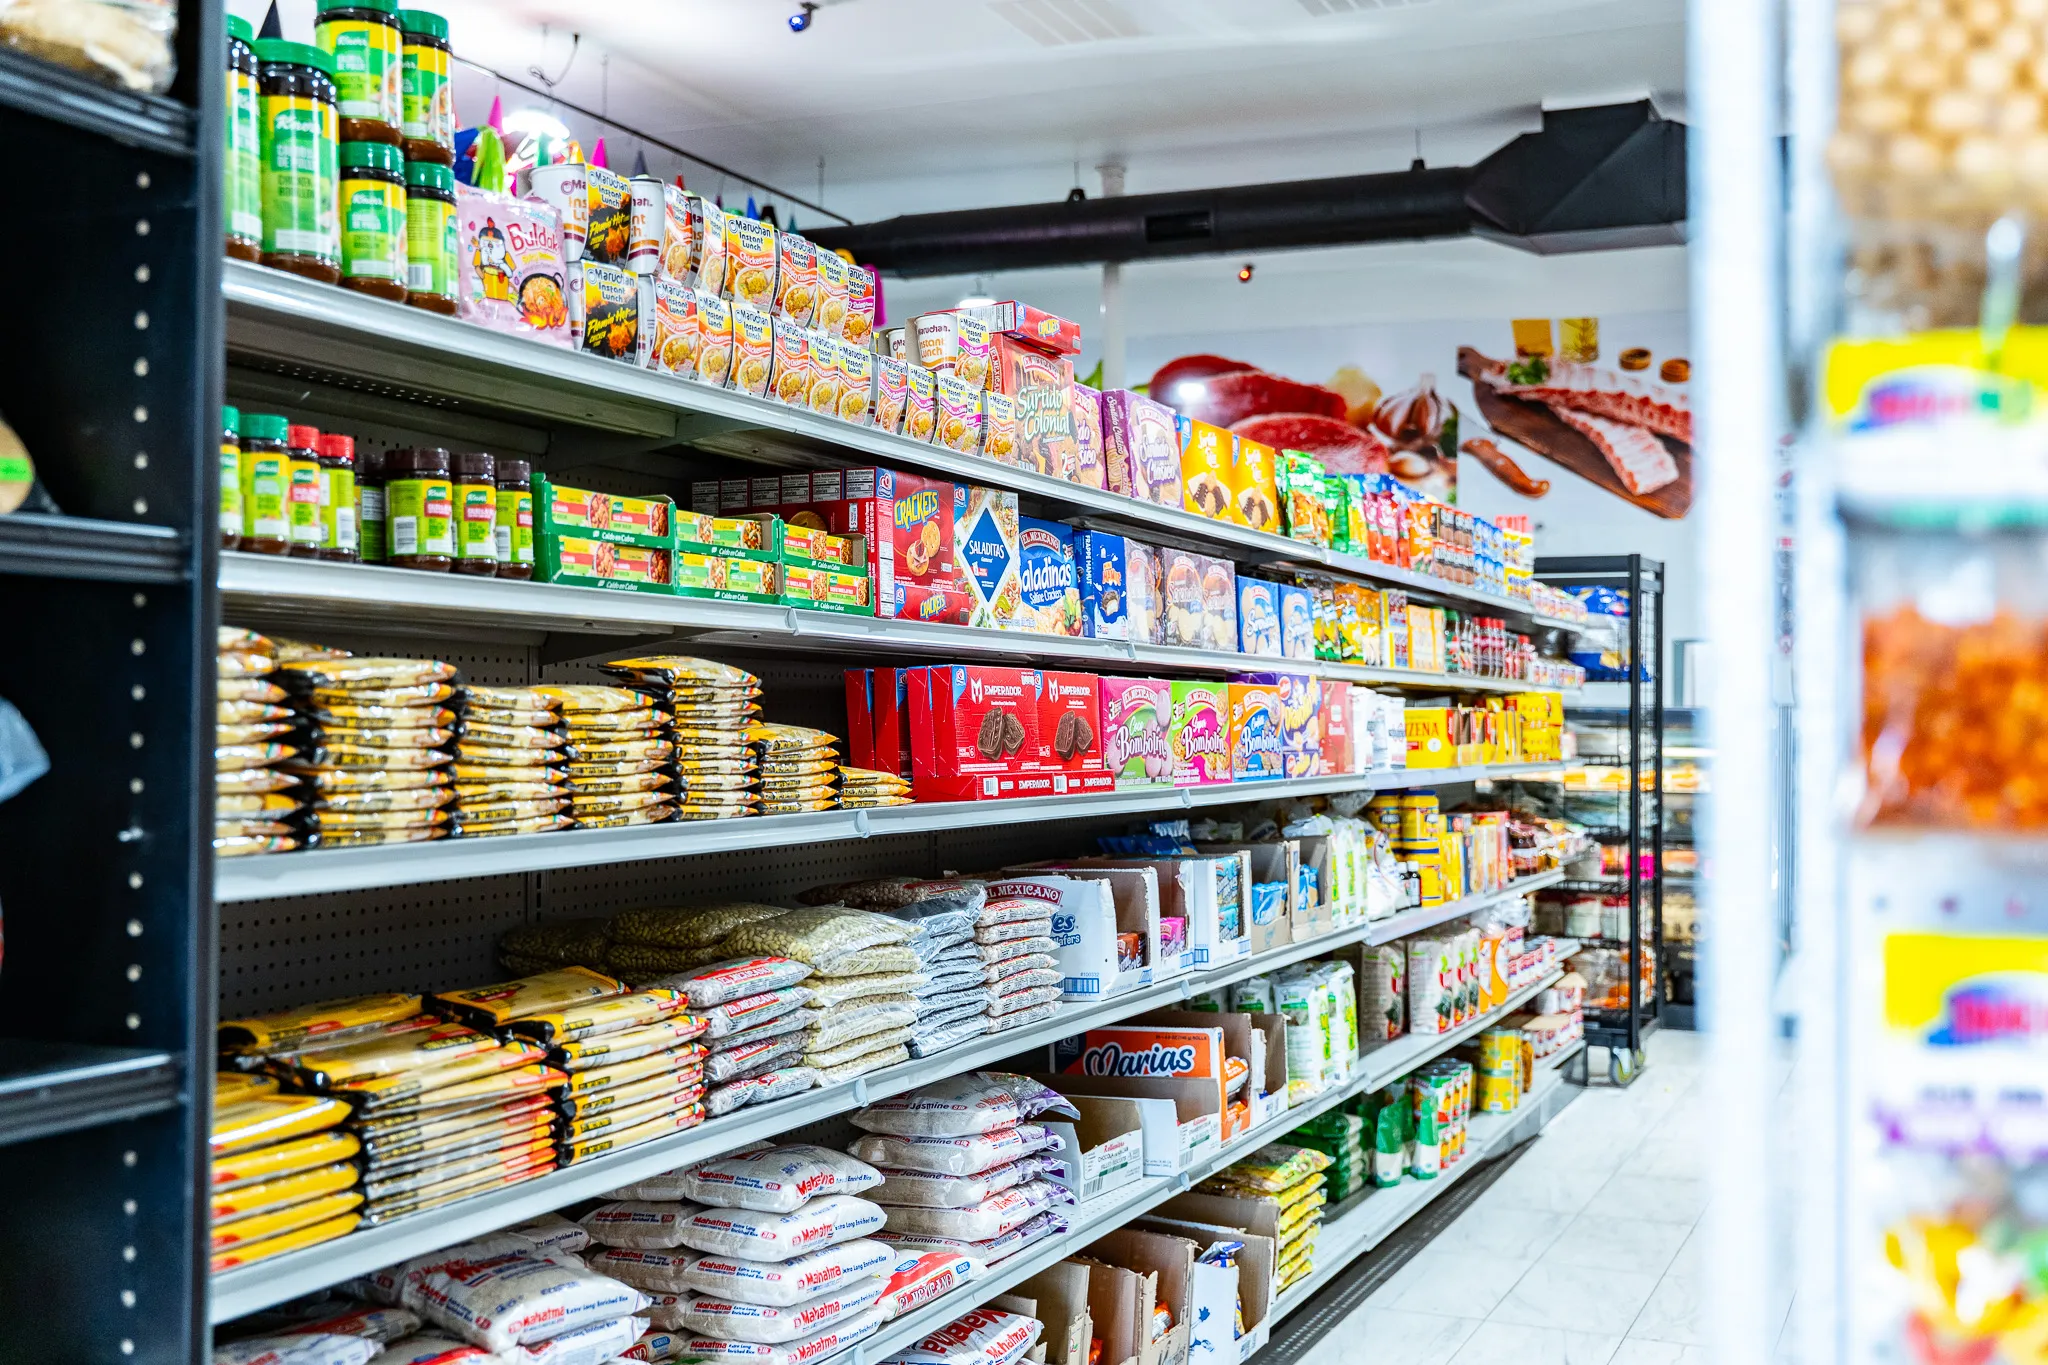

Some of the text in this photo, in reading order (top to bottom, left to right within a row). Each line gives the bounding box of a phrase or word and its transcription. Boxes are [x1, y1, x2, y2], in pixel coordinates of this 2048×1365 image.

[595, 171, 630, 194] Maruchan
[735, 220, 771, 237] Maruchan
[507, 222, 560, 251] Buldak
[739, 232, 763, 244] Instant
[742, 242, 762, 251] Lunch
[787, 238, 815, 254] Maruchan
[595, 269, 636, 288] Maruchan
[599, 283, 625, 295] Instant
[602, 291, 623, 302] Lunch
[662, 284, 694, 301] Maruchan
[740, 310, 768, 326] Maruchan
[843, 347, 870, 362] Maruchan
[1017, 386, 1063, 419] Surtido
[1025, 411, 1071, 441] Colonial
[895, 492, 939, 527] CRACKETS
[1023, 530, 1060, 551] EL MEXICANO
[969, 540, 1005, 559] SALADITAS
[921, 595, 945, 618] CRACKETS
[984, 685, 1022, 696] EMPERADOR
[1059, 685, 1091, 696] EMPERADOR
[1018, 780, 1050, 789] EMPERADOR
[1084, 778, 1113, 787] EMPERADOR
[998, 884, 1059, 900] MEXICANO
[726, 993, 778, 1015] EL MEXICANO
[698, 1171, 734, 1181] Mahatma
[901, 1170, 942, 1180] Jasmine
[734, 1180, 752, 1188] Enriched
[694, 1216, 731, 1227] Mahatma
[845, 1221, 855, 1229] Long
[731, 1228, 748, 1236] Enriched
[901, 1235, 942, 1244] Jasmine
[699, 1260, 737, 1271] Mahatma
[805, 1263, 841, 1284] Mahatma
[853, 1263, 863, 1271] Long
[878, 1255, 887, 1263] Rice
[736, 1271, 754, 1279] Enriched
[899, 1272, 954, 1311] EL MEXICANO
[523, 1305, 565, 1328] Mahatma
[583, 1303, 596, 1313] Long
[596, 1297, 618, 1307] Enriched
[696, 1301, 732, 1311] Mahatma
[801, 1300, 840, 1325] Mahatma
[841, 1303, 851, 1311] Extra
[850, 1299, 860, 1308] Long
[690, 1340, 727, 1350] Mahatma
[798, 1331, 859, 1361] Mahatma Extra Long
